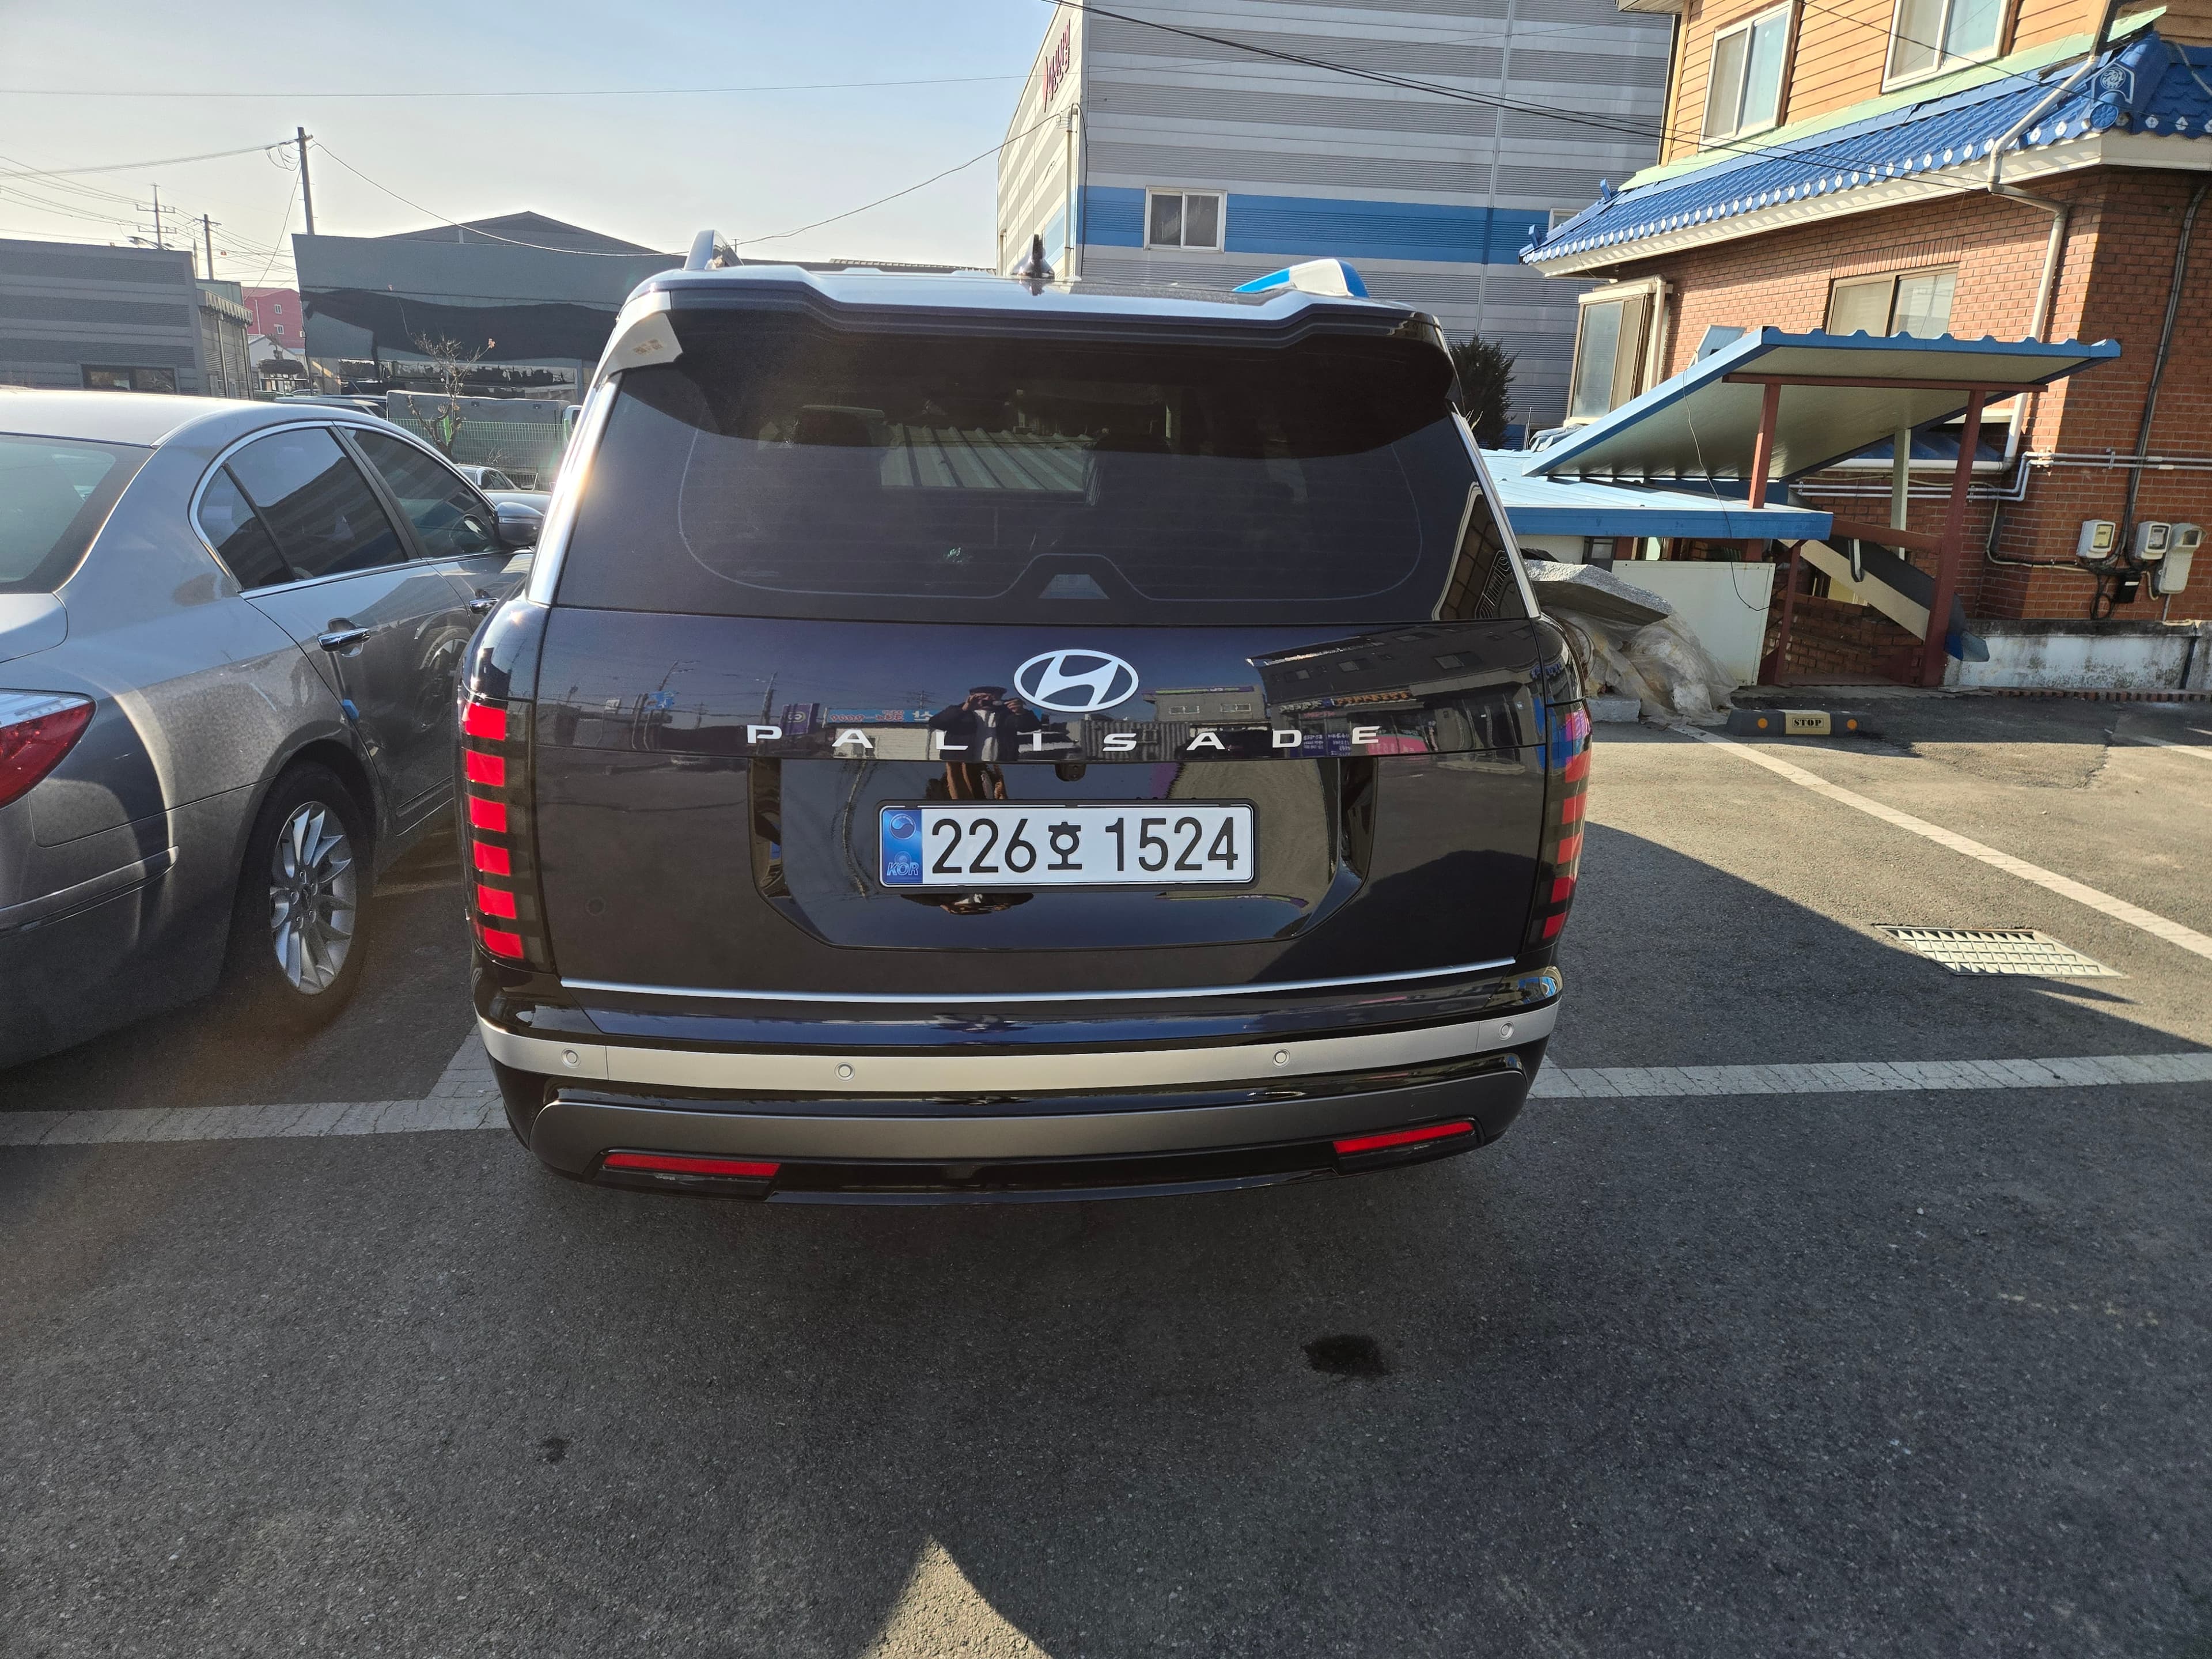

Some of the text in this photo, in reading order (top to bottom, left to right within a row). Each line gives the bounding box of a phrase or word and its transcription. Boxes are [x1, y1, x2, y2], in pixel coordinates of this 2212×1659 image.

[747, 725, 1381, 751] PALISADE
[932, 817, 1238, 873] 226호 1524
[887, 862, 919, 876] KOR
